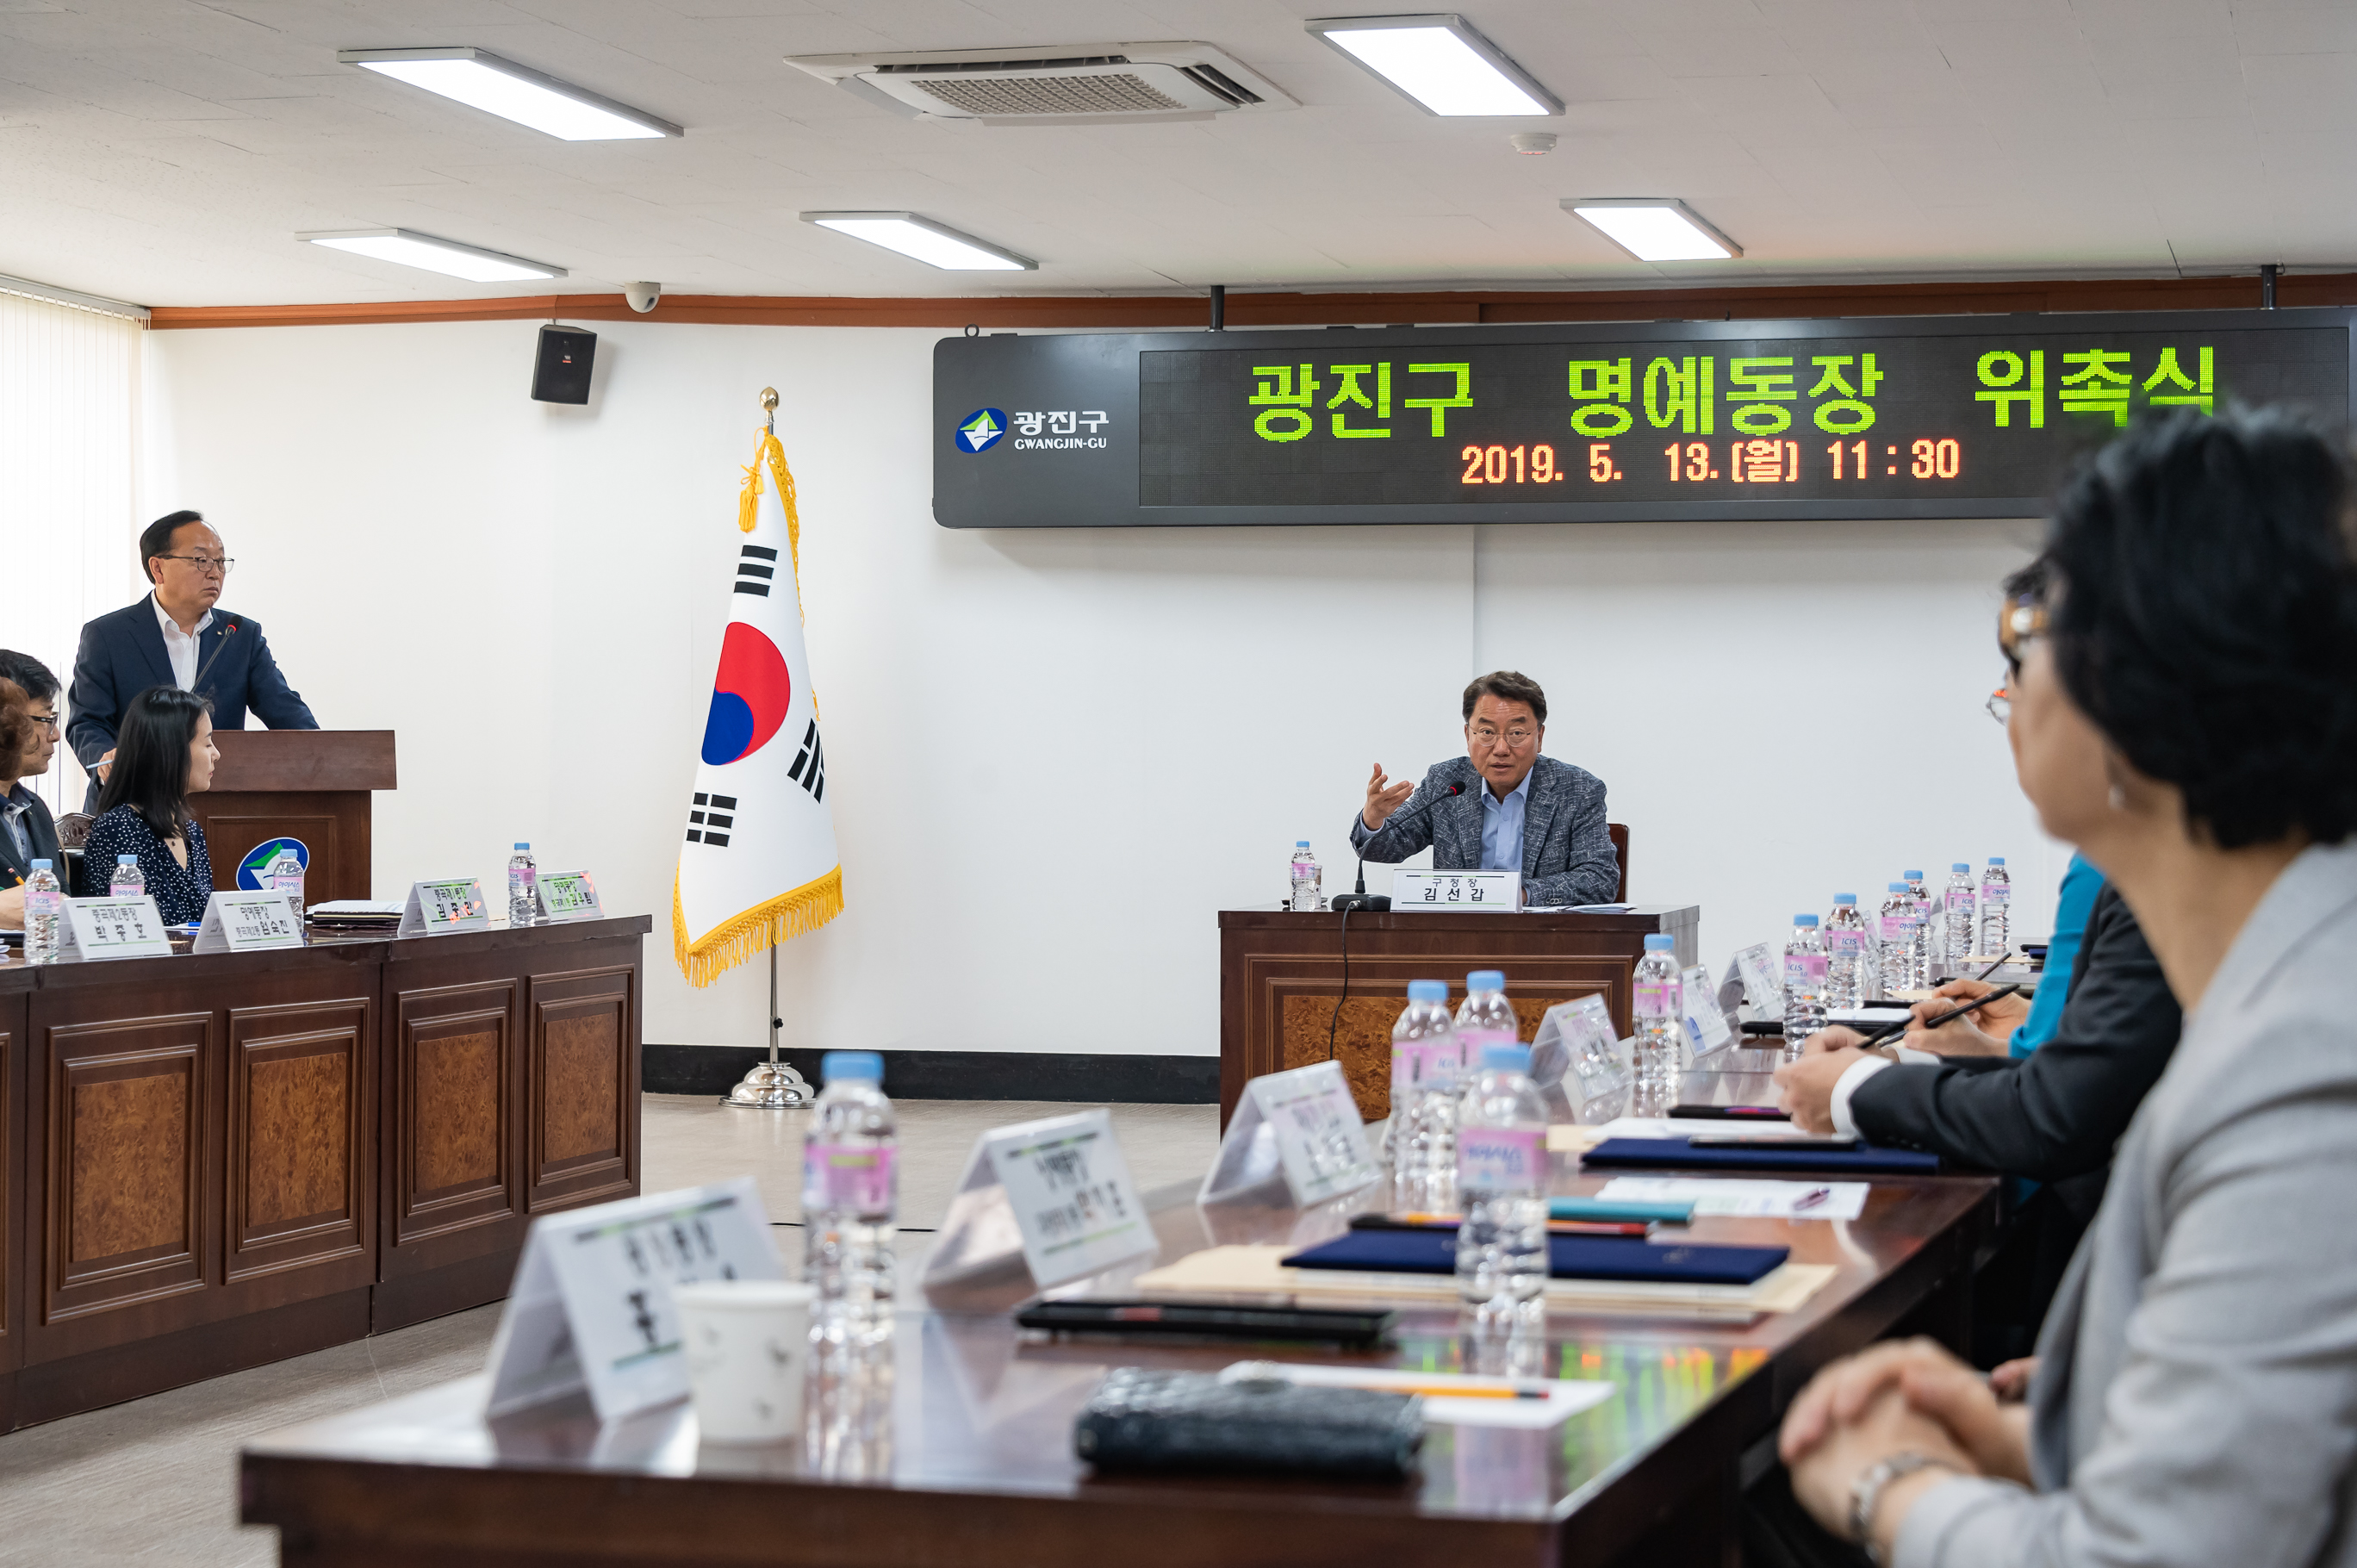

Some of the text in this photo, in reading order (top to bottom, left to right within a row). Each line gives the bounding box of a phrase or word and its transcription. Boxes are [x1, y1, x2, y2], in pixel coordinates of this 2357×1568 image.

[1249, 345, 2214, 443] 광진구 명예동장 위촉식
[1013, 411, 1110, 436] 광진구
[1014, 437, 1107, 450] GWANGJIN-GU
[1462, 444, 1564, 484] 2019.
[1589, 443, 1623, 482] 5.
[1432, 878, 1478, 888] 구청장
[1424, 887, 1484, 902] 김선갑
[91, 907, 138, 923] 중곡제2동장
[239, 906, 270, 921] 명예동장
[1788, 962, 1803, 971] ICIS
